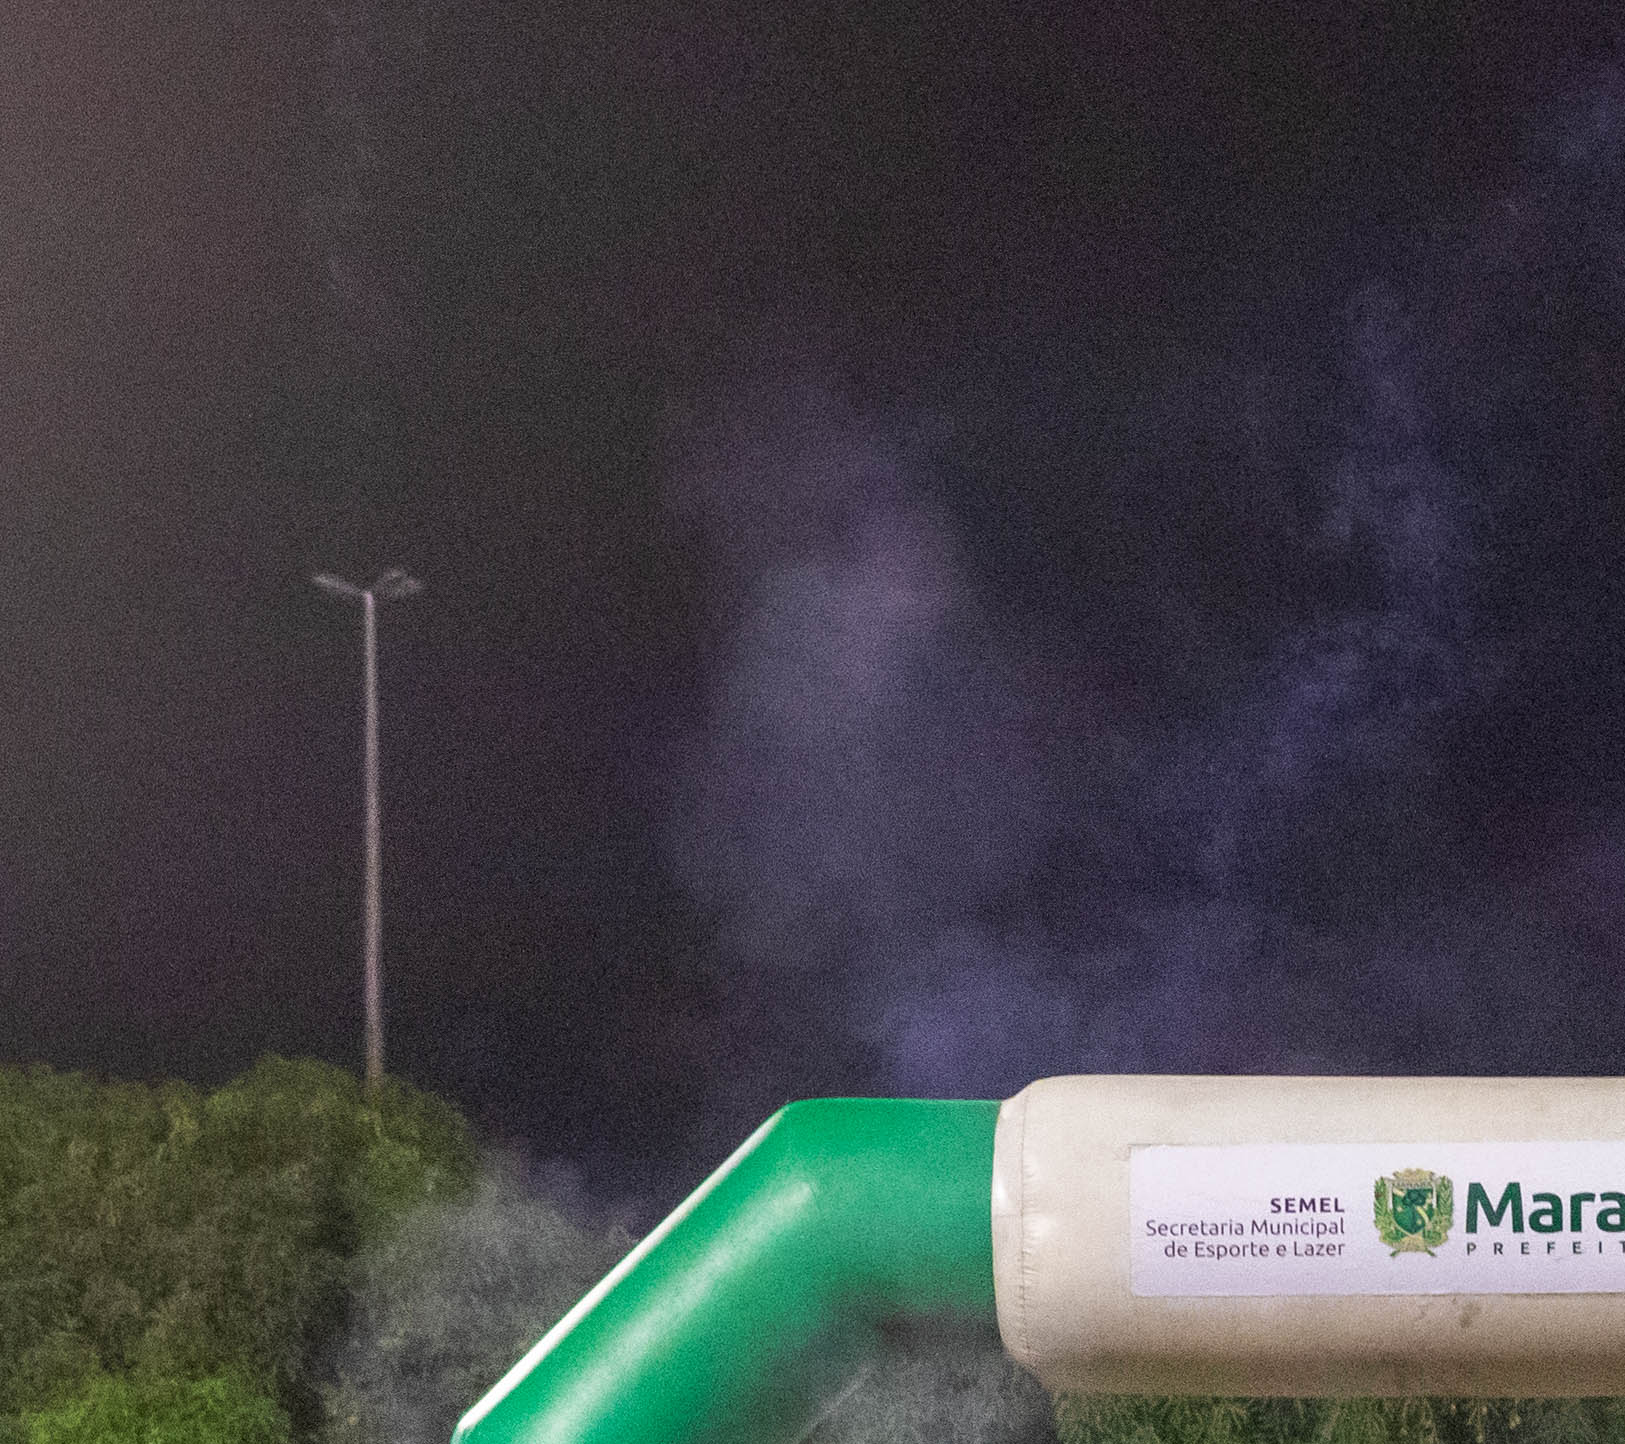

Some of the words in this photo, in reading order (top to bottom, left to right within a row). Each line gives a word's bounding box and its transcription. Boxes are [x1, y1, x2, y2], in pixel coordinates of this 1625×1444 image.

[1270, 1198, 1344, 1213] SEMEL
[1146, 1218, 1245, 1236] Secretaria
[1256, 1217, 1345, 1239] Municipal
[1164, 1239, 1187, 1257] de
[1195, 1240, 1269, 1261] Esporte
[1276, 1244, 1288, 1257] e
[1294, 1239, 1345, 1257] Lazer
